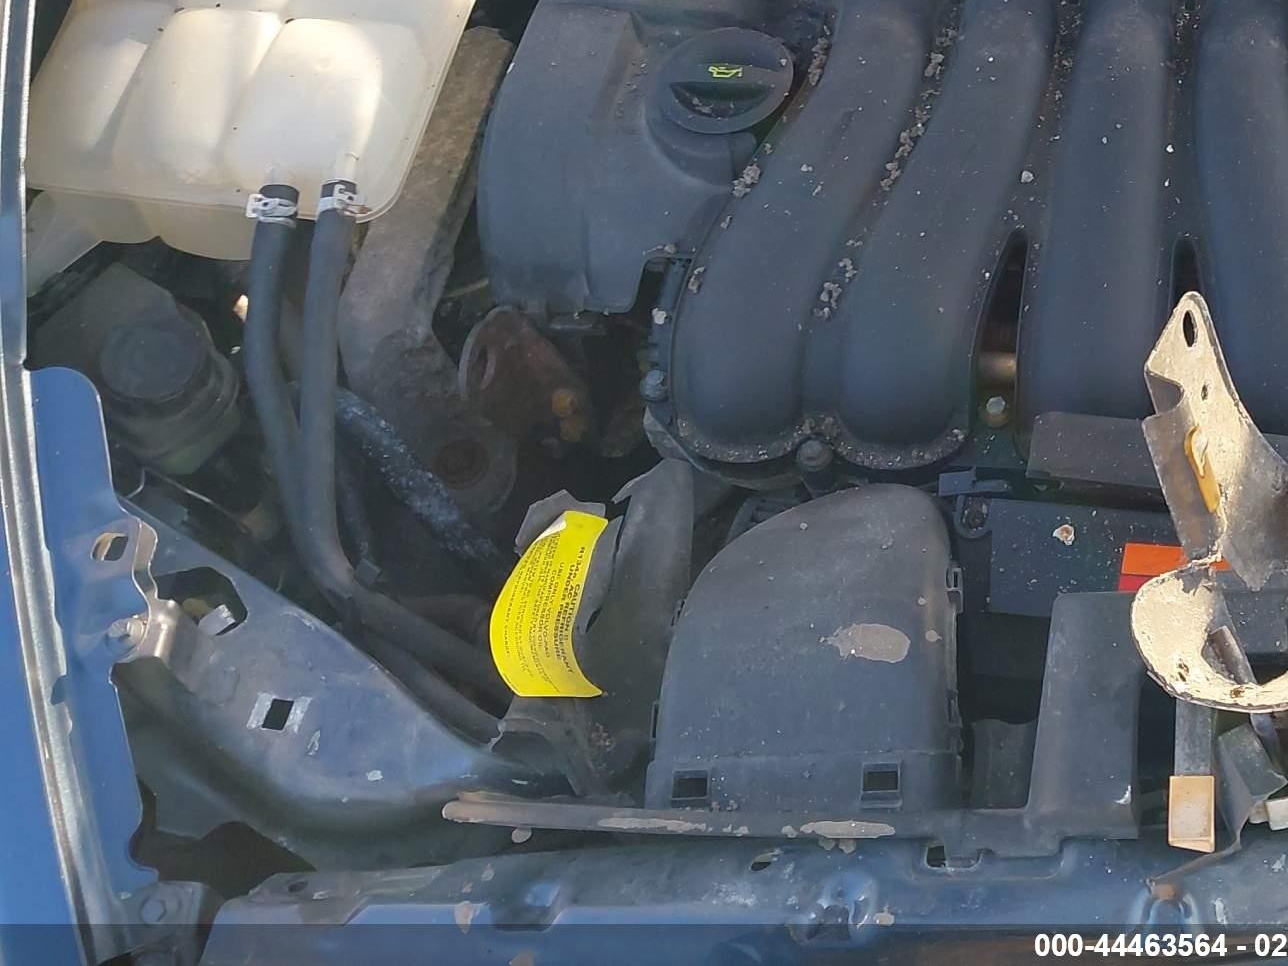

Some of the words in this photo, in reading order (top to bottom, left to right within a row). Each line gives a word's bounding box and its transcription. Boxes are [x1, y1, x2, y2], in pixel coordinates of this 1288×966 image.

[561, 565, 575, 601] UNDER
[565, 584, 580, 631] CAUTION
[560, 602, 574, 673] REFRIGERANT
